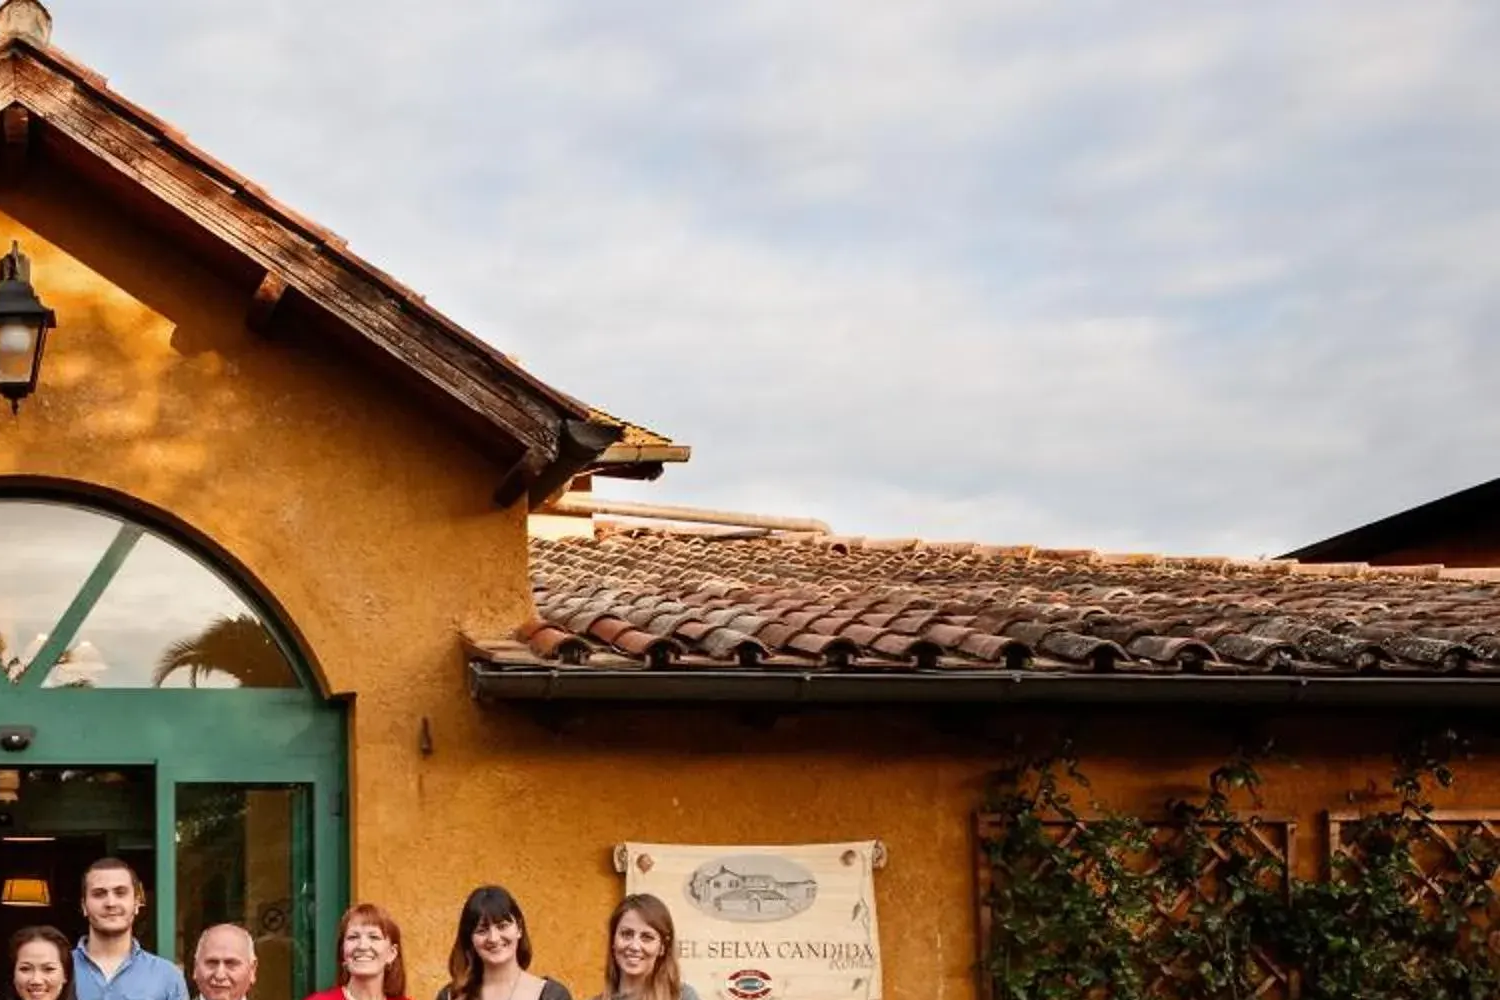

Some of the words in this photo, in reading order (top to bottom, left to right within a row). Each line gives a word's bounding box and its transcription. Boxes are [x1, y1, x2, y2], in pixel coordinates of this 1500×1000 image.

[678, 941, 703, 959] EL
[707, 941, 770, 959] SELVA
[777, 941, 875, 960] CANDIDA
